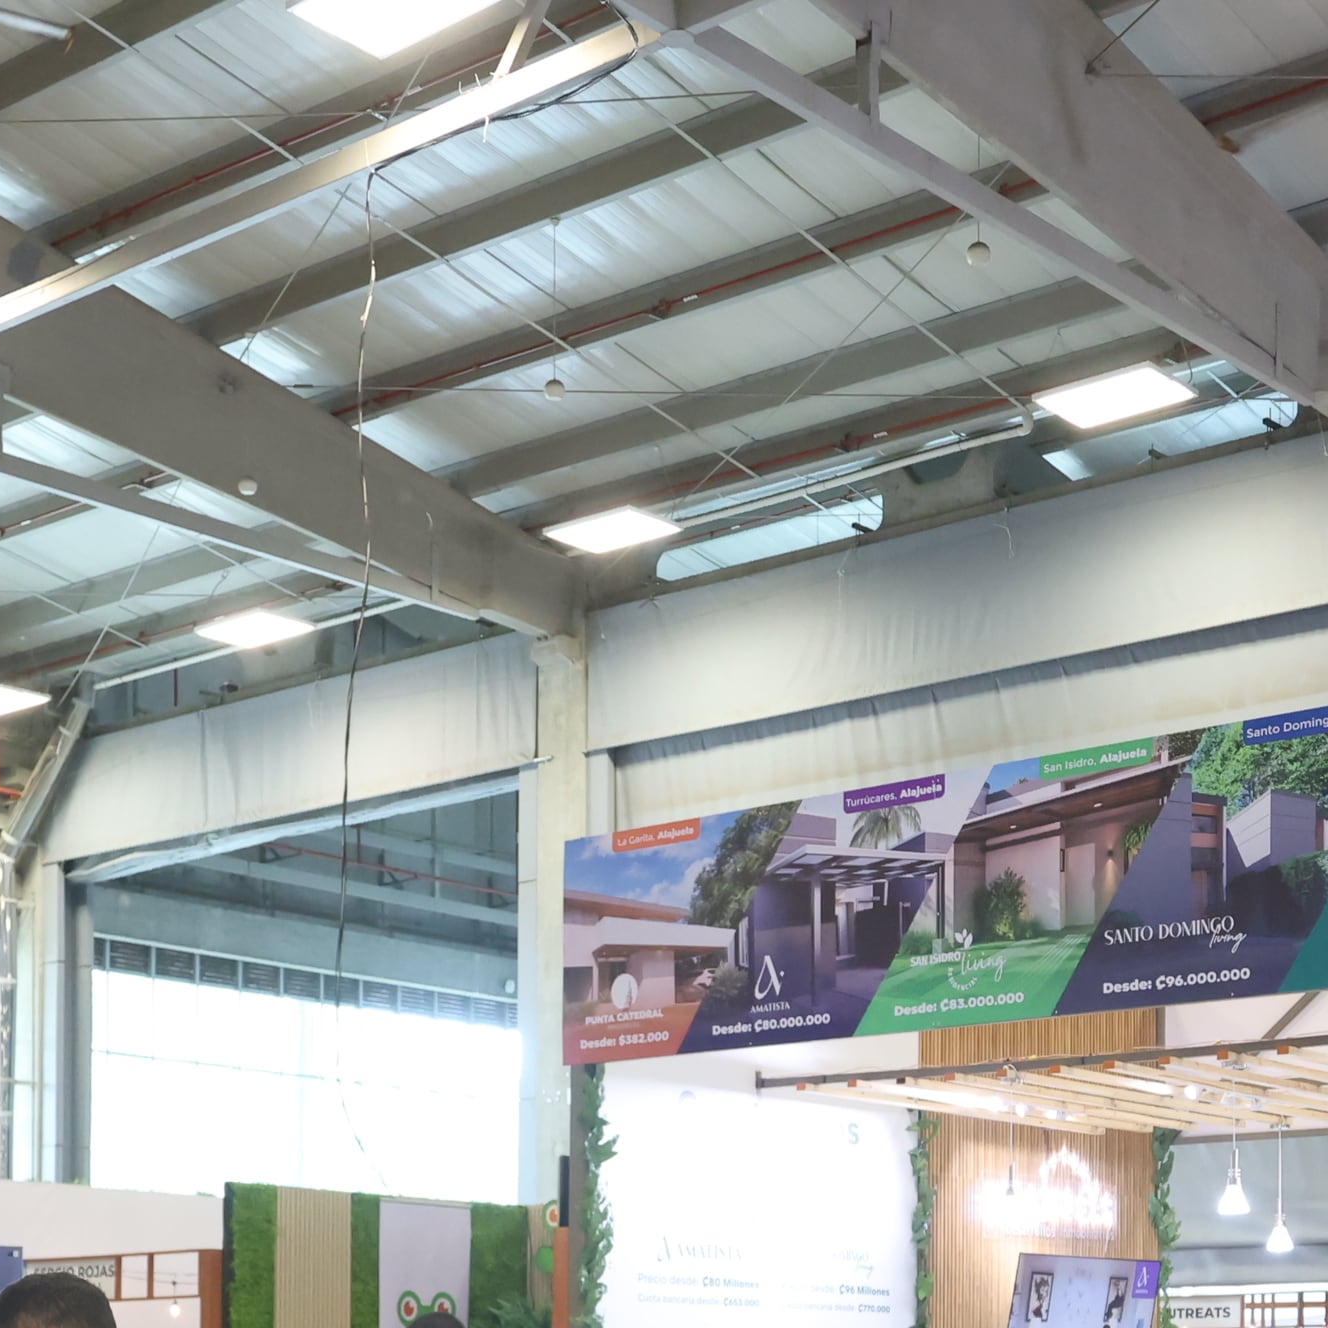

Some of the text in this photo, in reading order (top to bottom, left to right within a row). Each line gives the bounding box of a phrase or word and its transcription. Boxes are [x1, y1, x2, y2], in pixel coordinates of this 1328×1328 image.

[1246, 724, 1281, 739] Santo
[1043, 747, 1148, 774] San Isidro, Alajuela
[899, 782, 944, 800] Alajuela
[657, 825, 695, 841] Alajuela
[1103, 914, 1235, 946] SANTO DOMINGO
[1208, 927, 1248, 955] living
[910, 950, 962, 968] SAN ISIDRO
[960, 951, 1007, 983] living
[1102, 979, 1153, 994] Desde:
[750, 1001, 791, 1014] AMATISTA
[894, 1003, 937, 1016] Desde:
[585, 1008, 664, 1026] PUNTA CATEDRAL
[712, 1023, 752, 1036] Desde:
[580, 1031, 670, 1050] Desde: $382.000
[78, 1264, 114, 1279] ROJAS
[723, 1278, 760, 1289] Millones
[857, 1286, 891, 1297] Millones
